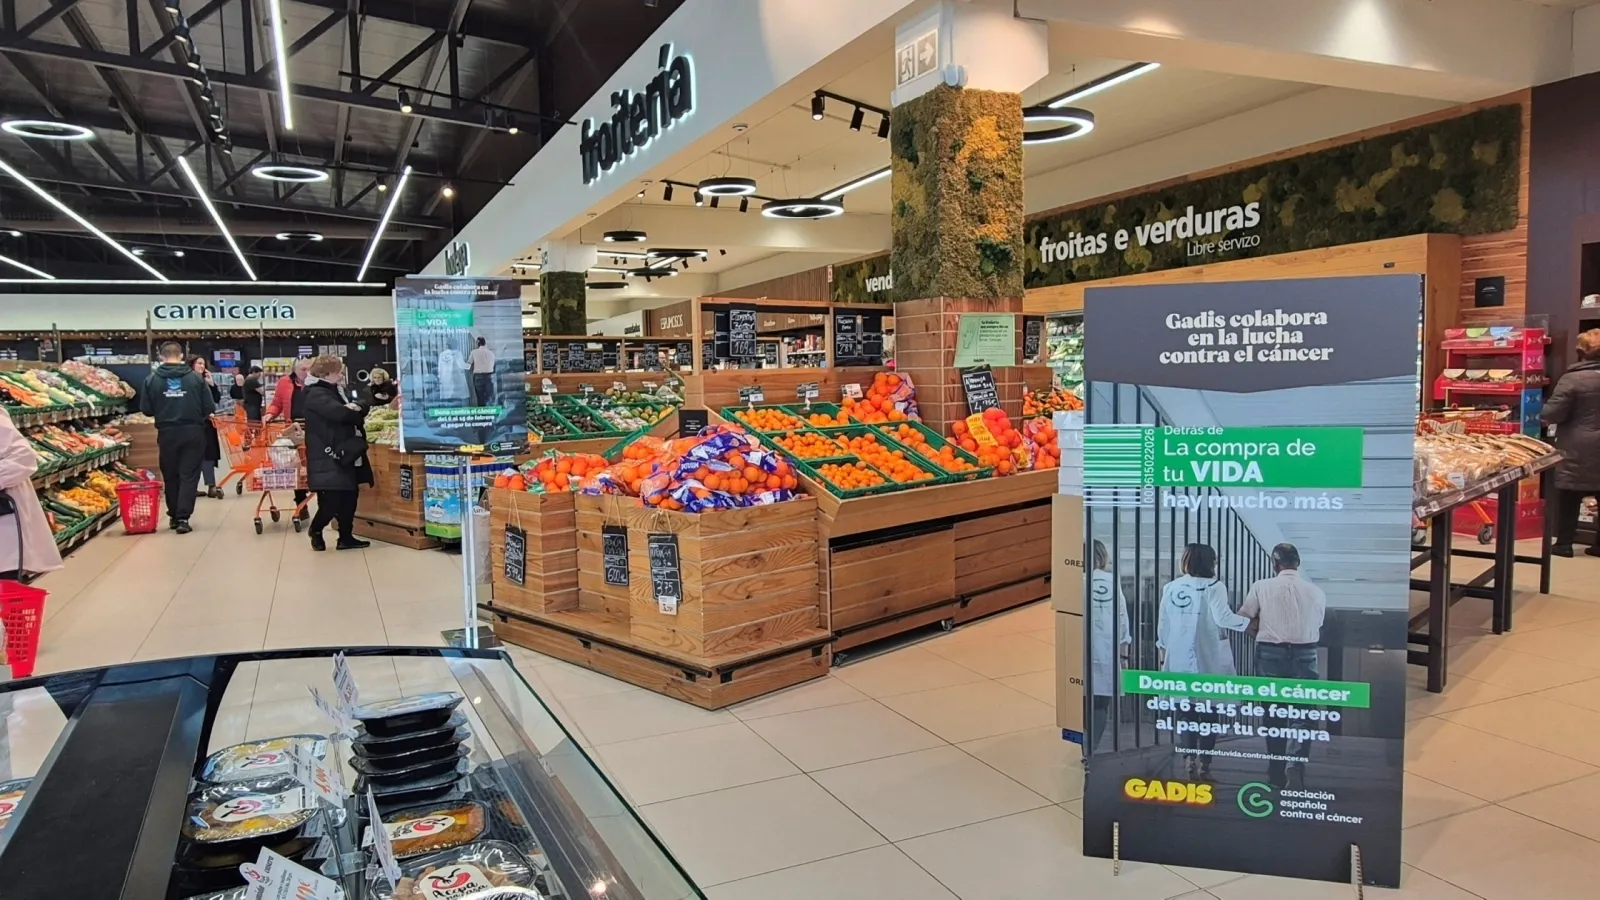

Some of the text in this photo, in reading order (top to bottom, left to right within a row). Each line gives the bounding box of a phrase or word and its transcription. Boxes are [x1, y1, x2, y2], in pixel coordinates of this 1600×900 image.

[580, 42, 696, 187] froitería
[1039, 202, 1261, 264] froitas e verduras
[1186, 232, 1261, 257] Libre servizo
[153, 298, 296, 320] carnicería
[1165, 309, 1328, 330] Gadis colabora
[1188, 327, 1304, 346] en la lucha
[1159, 343, 1334, 364] contra el cáncer
[1164, 425, 1224, 437] Detrás de
[1164, 439, 1316, 462] La compra de
[1144, 428, 1156, 505] 000615022026
[1163, 460, 1264, 483] tu VIDA
[1163, 492, 1344, 513] hay mucho más
[1138, 675, 1351, 702] Dona contra el cáncer
[1146, 697, 1341, 723] del 6 al 15 de febrero
[1155, 717, 1331, 744] al pagar tu compra
[1175, 746, 1309, 763] lacompradetuvida.contraelcancer.es
[1124, 778, 1213, 804] GADIS
[1280, 788, 1335, 801] asociación
[1280, 799, 1328, 812] española
[1280, 809, 1364, 824] contra el cáncer
